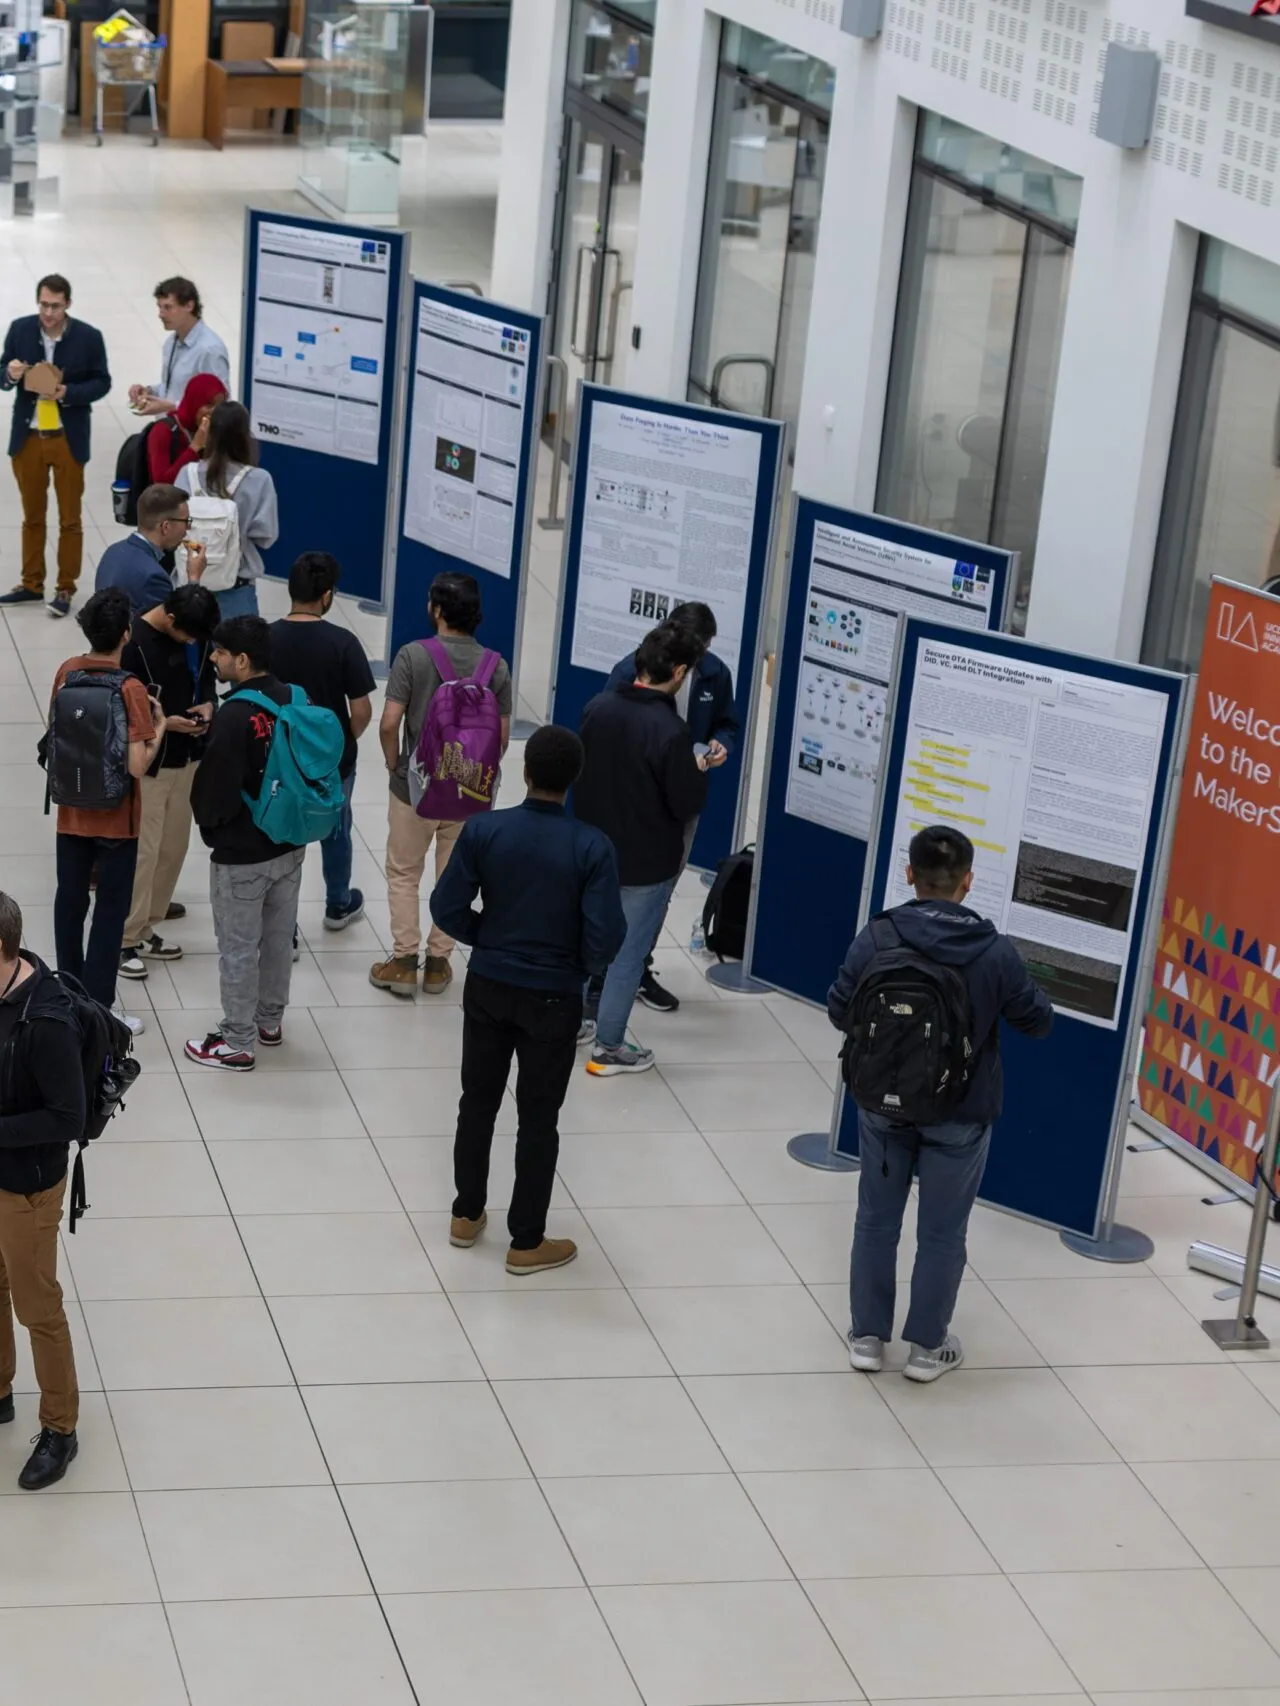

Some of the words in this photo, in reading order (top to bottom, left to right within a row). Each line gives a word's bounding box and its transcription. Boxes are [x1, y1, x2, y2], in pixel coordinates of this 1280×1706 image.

[257, 422, 280, 436] TNO
[924, 648, 950, 660] Secure
[951, 653, 967, 664] OTA
[967, 658, 1002, 672] Firmware
[1003, 667, 1035, 680] Updates
[1035, 675, 1053, 684] with
[953, 664, 967, 672] and
[967, 666, 982, 676] DLT
[982, 670, 1026, 686] Integration
[1200, 732, 1225, 765] to
[1230, 745, 1272, 785] the
[1193, 771, 1280, 834] MakerS
